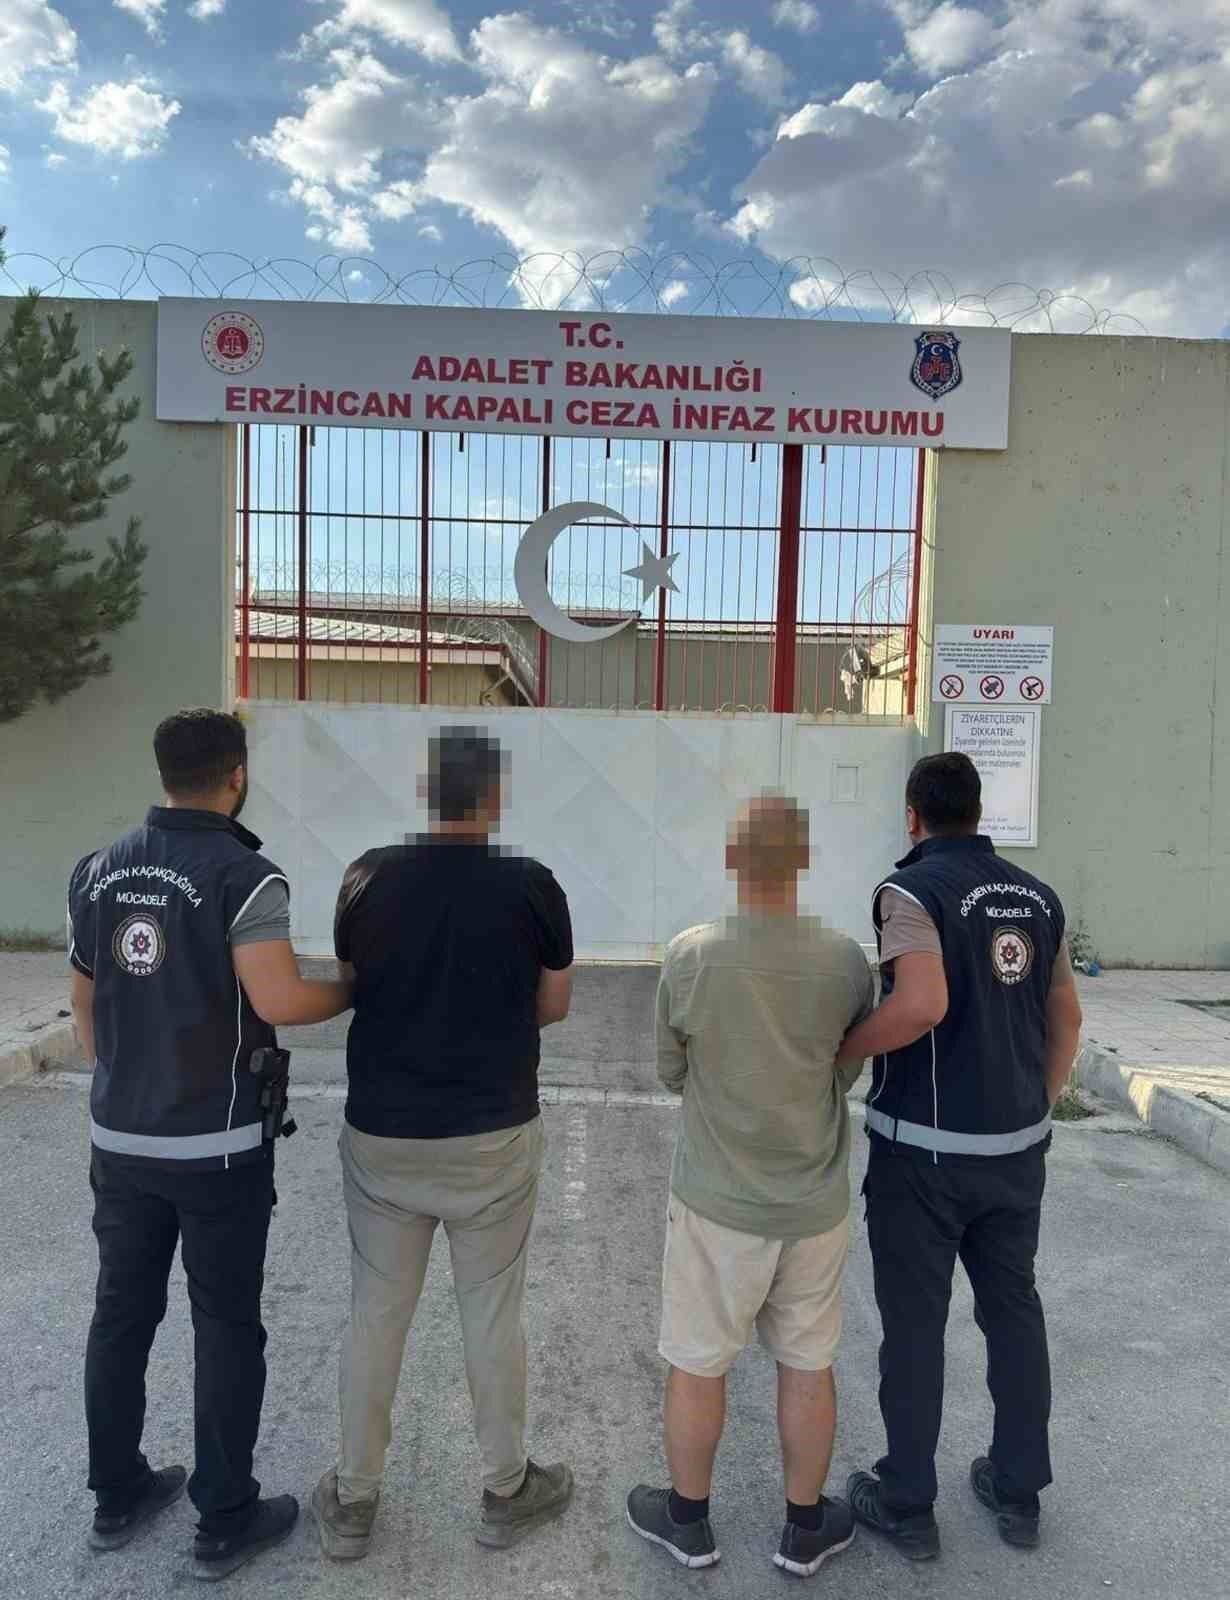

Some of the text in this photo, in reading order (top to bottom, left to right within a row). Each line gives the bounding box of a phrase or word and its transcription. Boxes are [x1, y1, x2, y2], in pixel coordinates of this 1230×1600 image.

[559, 322, 624, 350] T.C.
[411, 355, 762, 393] ADALET BAKANLIĞI
[225, 383, 945, 437] ERZİNCAN KAPALI CEZA İNFAZ KURUMU
[973, 629, 1015, 640] UYARI
[89, 864, 203, 908] GÖÇMEN KAÇAKÇILIĞIYLA
[116, 891, 168, 906] MÜCADELE
[985, 906, 1033, 918] MÜCADELE
